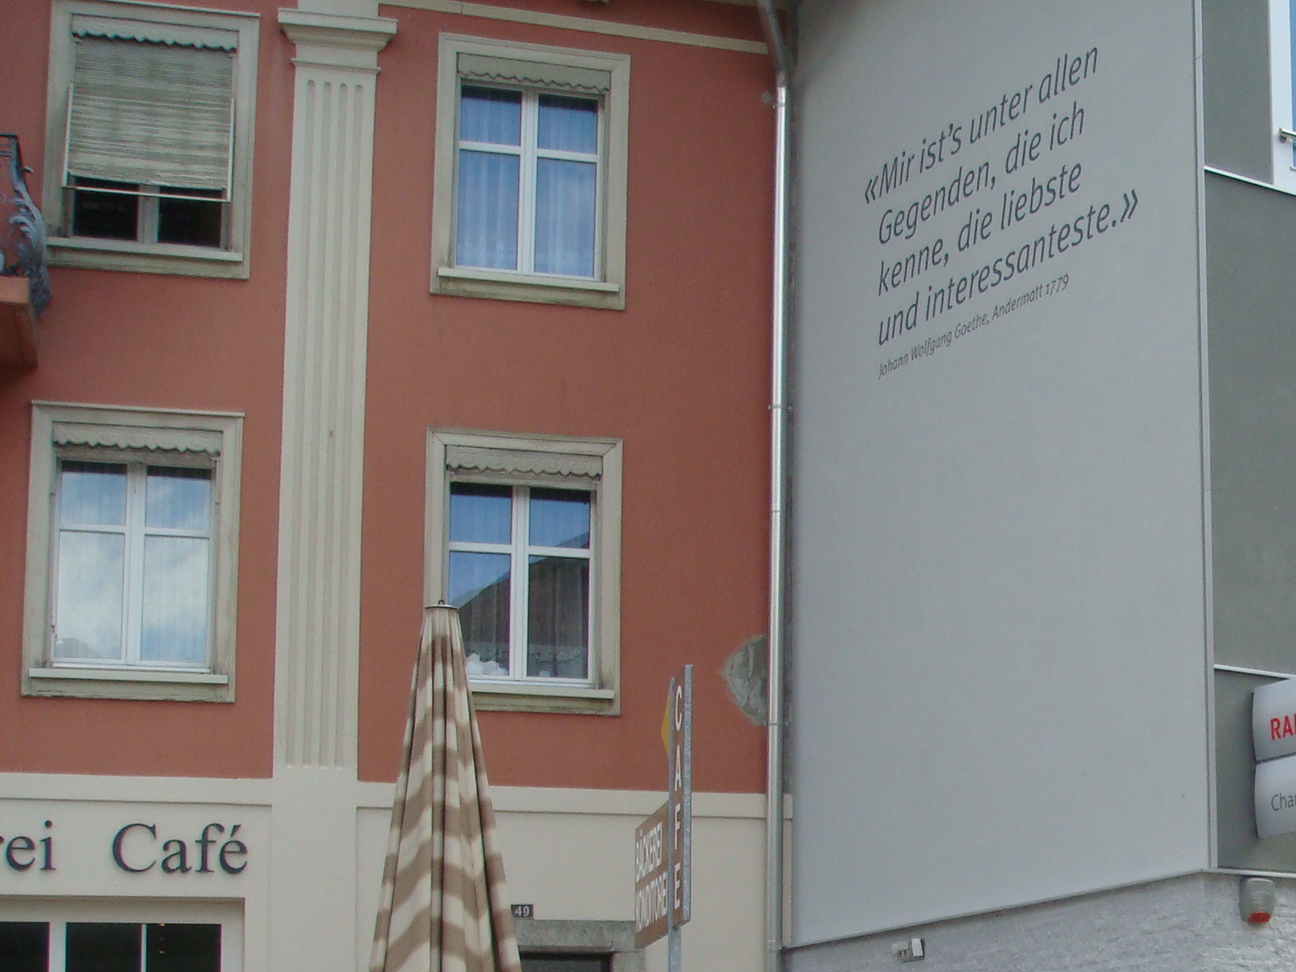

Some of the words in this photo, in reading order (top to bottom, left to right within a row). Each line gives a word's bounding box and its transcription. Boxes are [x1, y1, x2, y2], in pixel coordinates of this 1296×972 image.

[969, 84, 1033, 145] unter
[1038, 47, 1098, 103] allen
[879, 161, 996, 245] Gegenden,
[1005, 129, 1042, 175] die
[1049, 101, 1085, 151] ich
[878, 238, 949, 297] kenne,
[957, 208, 993, 252] die
[1001, 162, 1082, 231] liebste
[878, 353, 909, 380] Johann
[911, 330, 953, 361] Wolfgang
[954, 313, 990, 338] Goethe,
[992, 284, 1043, 321] Andermatt
[1045, 274, 1070, 297] 1779
[879, 291, 920, 346] und
[0, 820, 57, 872] ei
[112, 822, 248, 874] Café
[514, 906, 531, 917] 49
